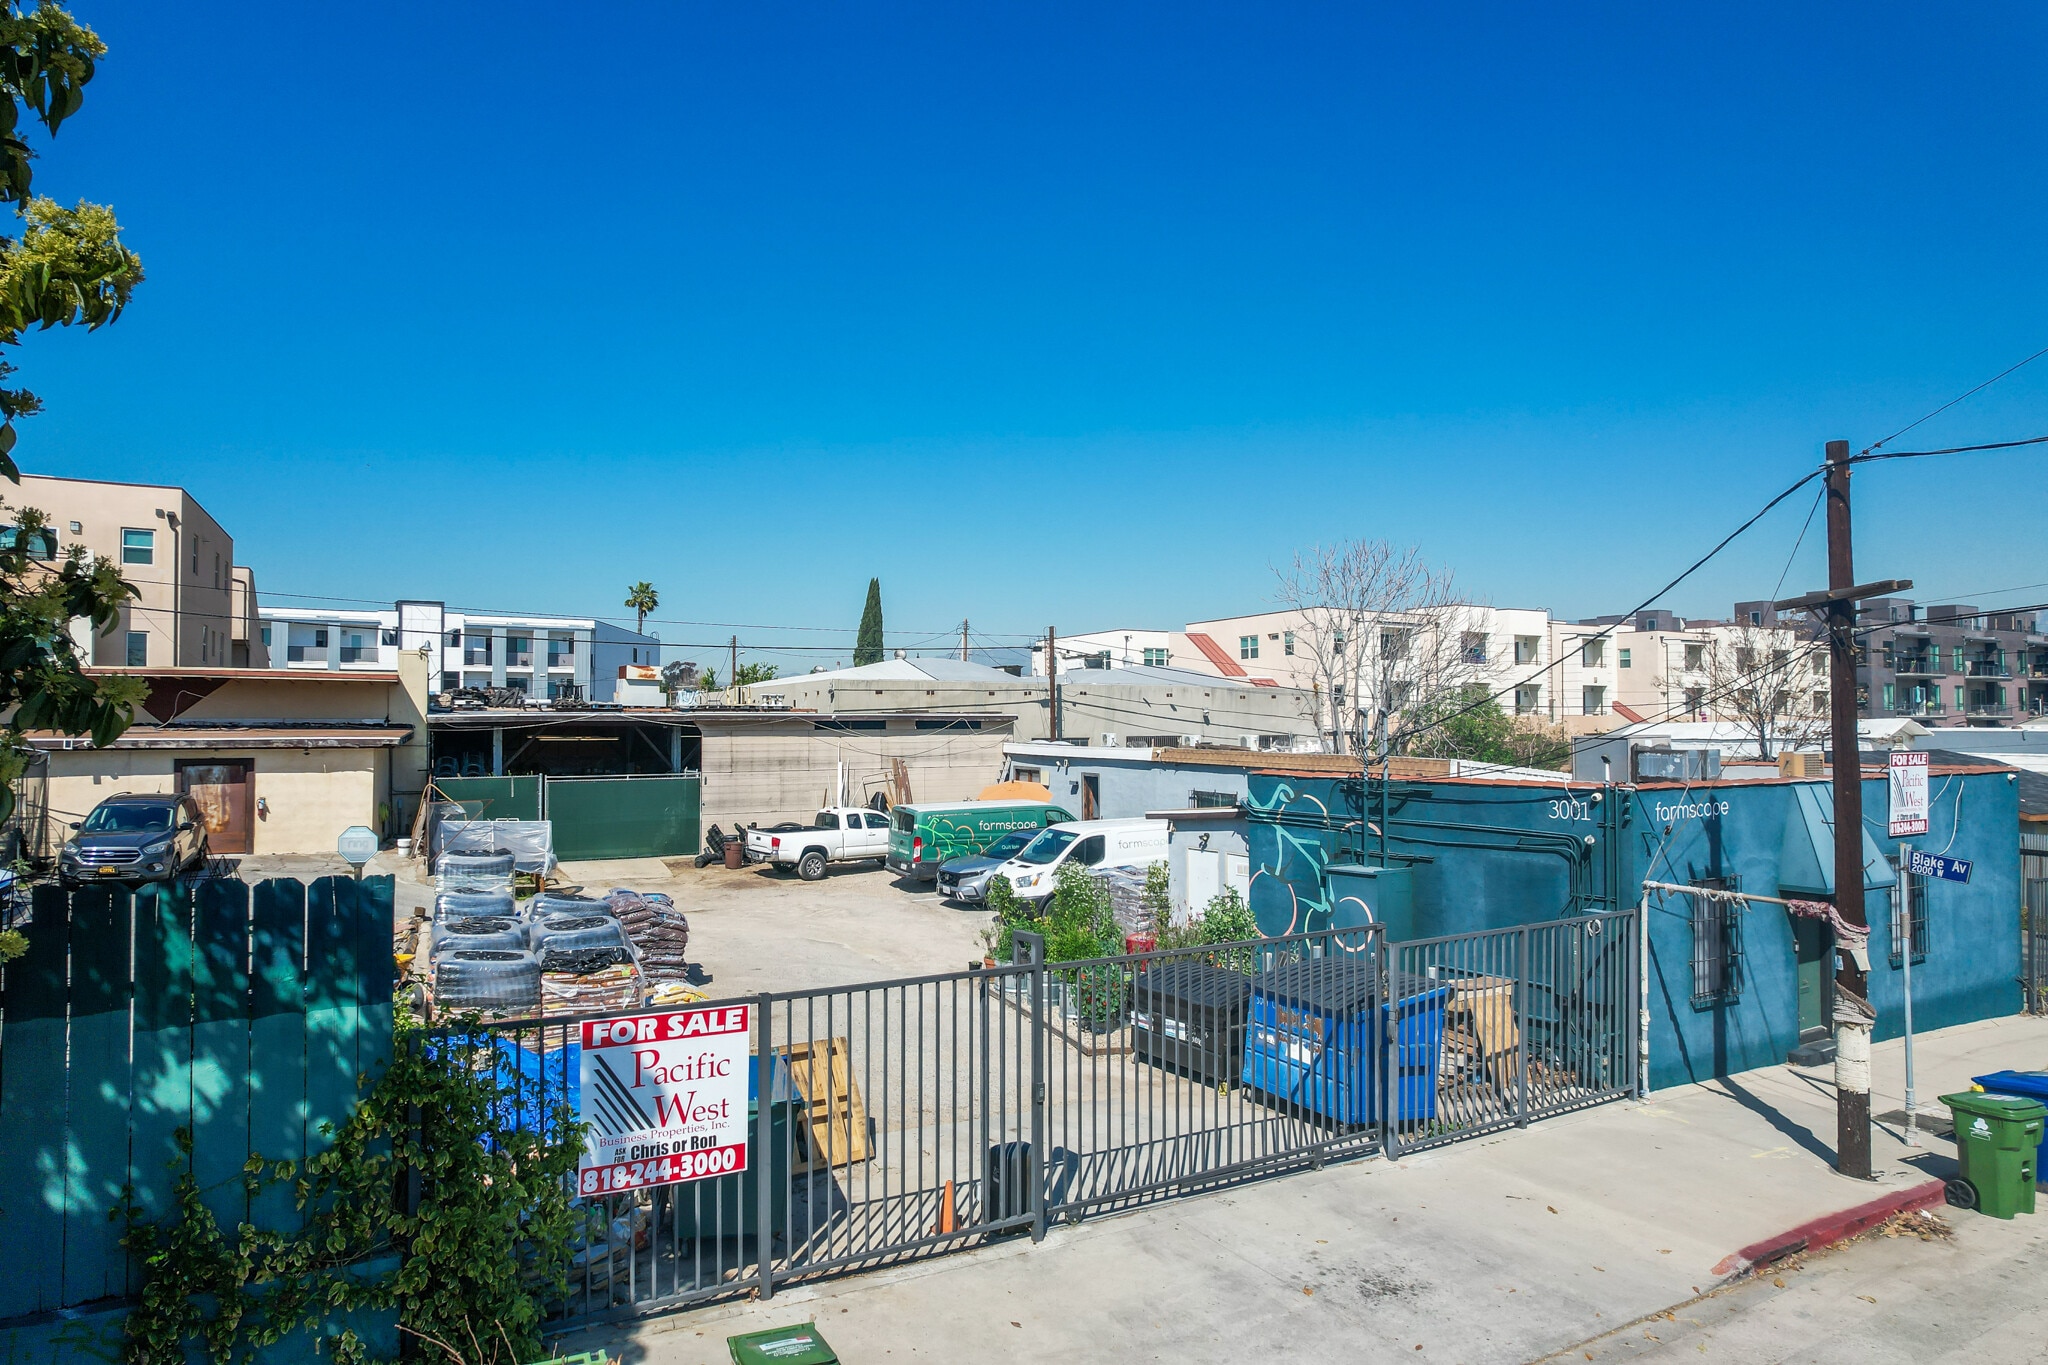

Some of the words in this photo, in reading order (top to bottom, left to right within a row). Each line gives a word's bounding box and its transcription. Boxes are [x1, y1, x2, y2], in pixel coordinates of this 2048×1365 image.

[1892, 754, 1907, 766] FOR
[1908, 754, 1926, 765] SALE
[1902, 769, 1923, 788] Pacific
[1905, 791, 1923, 807] West
[1549, 799, 1591, 821] 3001
[1655, 801, 1729, 822] farmscape
[979, 820, 1037, 831] farmscape
[1118, 838, 1168, 849] farmscap
[1911, 864, 1933, 876] 2000
[1937, 869, 1944, 877] W
[1912, 852, 1944, 869] Blake
[1951, 860, 1967, 874] Av
[592, 1018, 658, 1046] FOR
[667, 1008, 743, 1038] SALE
[630, 1049, 731, 1089] Pacific
[652, 1090, 730, 1128] West
[600, 1133, 648, 1148] Business
[651, 1124, 708, 1139] Properties,
[711, 1120, 730, 1130] Inc.
[614, 1147, 627, 1156] ASK
[631, 1141, 669, 1160] Chris
[672, 1139, 687, 1153] or
[690, 1135, 717, 1150] Ron
[582, 1147, 736, 1192] 818-244-3000
[614, 1155, 625, 1164] FOR
